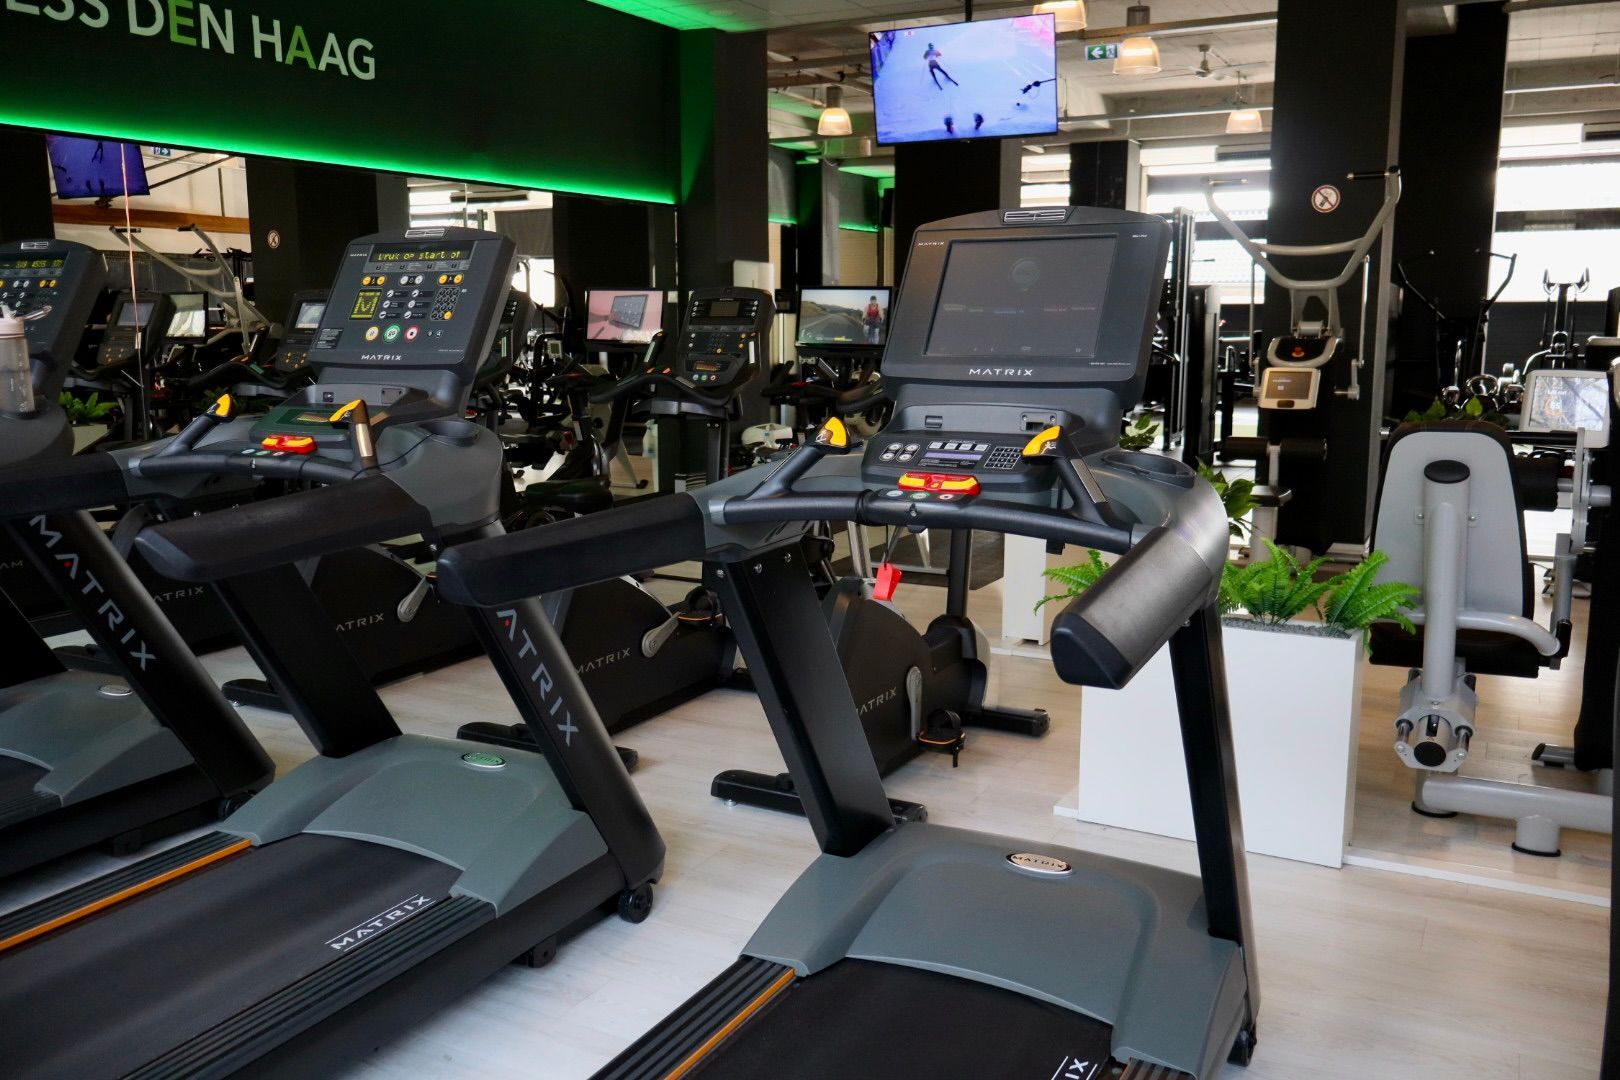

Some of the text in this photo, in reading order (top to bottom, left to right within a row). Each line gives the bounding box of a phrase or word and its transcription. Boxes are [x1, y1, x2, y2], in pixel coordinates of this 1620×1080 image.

[127, 0, 235, 55] DEN
[251, 14, 376, 80] HAAG
[968, 368, 1033, 376] MATRIX
[28, 515, 157, 672] MATRIX
[153, 585, 204, 603] ATRIX
[336, 612, 385, 632] ATRIX
[496, 608, 579, 747] ATRIX
[857, 686, 897, 716] ATRIX
[1012, 855, 1064, 868] MATRIX
[330, 896, 432, 950] MATRIX
